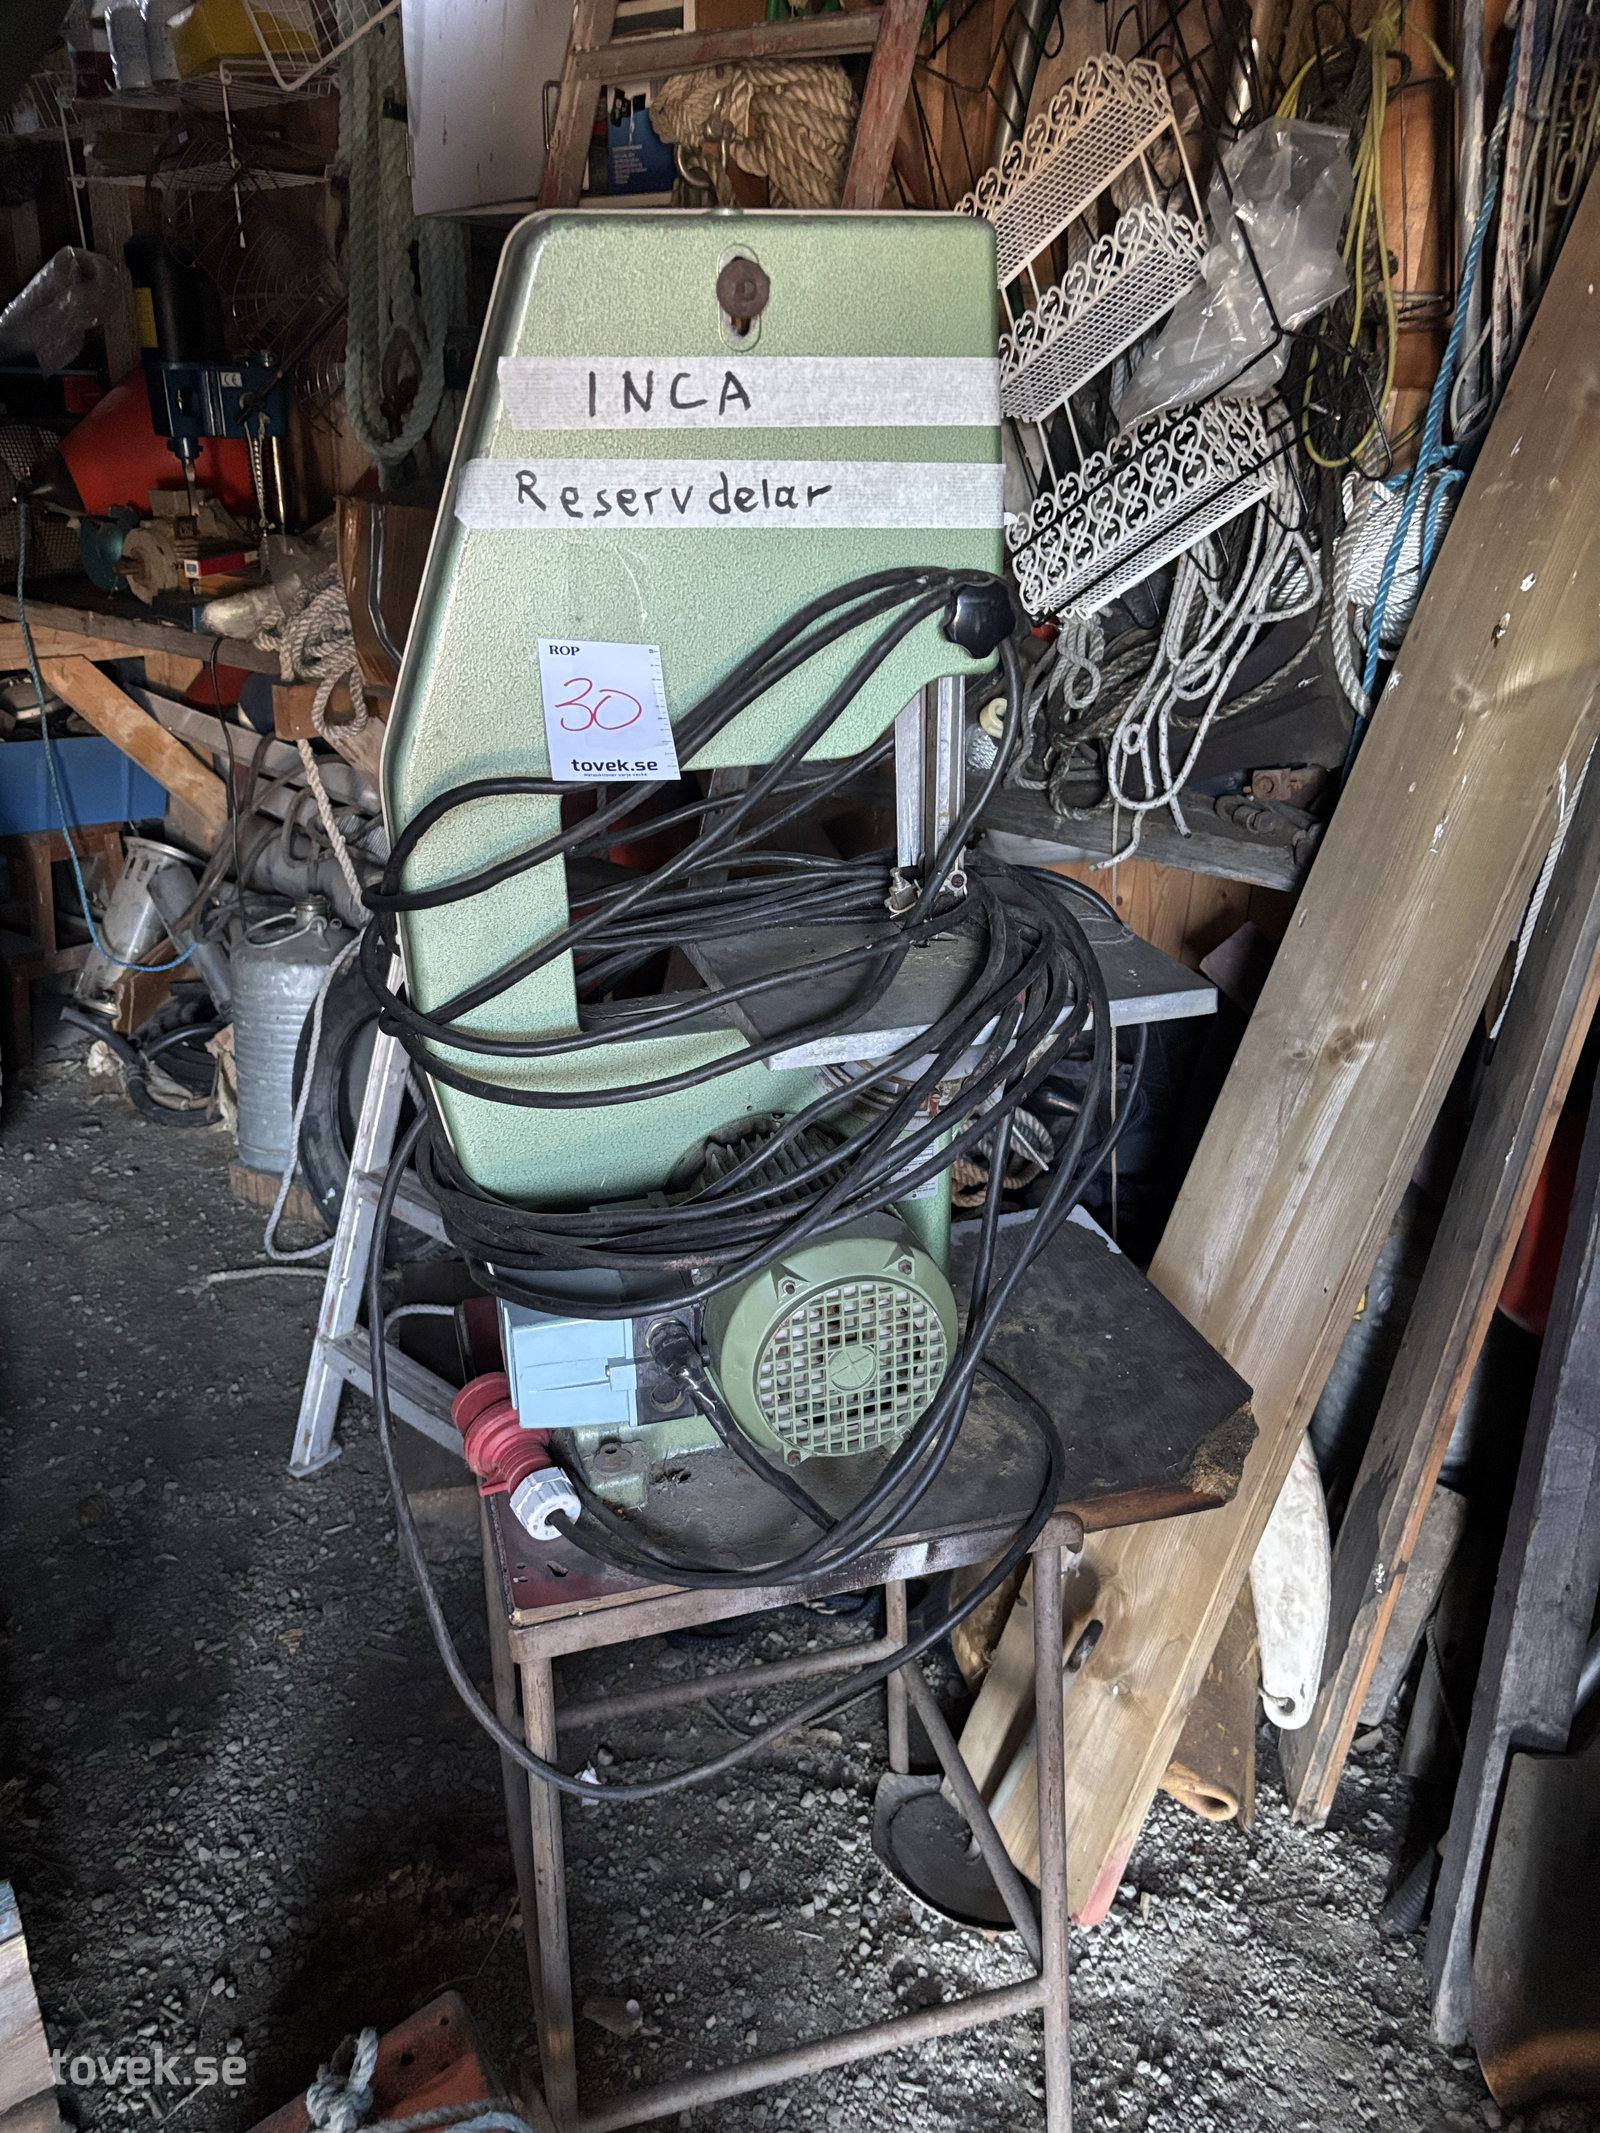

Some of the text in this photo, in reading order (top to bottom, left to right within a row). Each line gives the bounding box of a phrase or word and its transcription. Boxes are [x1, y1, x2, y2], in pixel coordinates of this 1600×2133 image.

[588, 370, 752, 418] INCA
[549, 645, 580, 656] ROP
[555, 677, 642, 732] 30
[571, 759, 658, 772] tovek.se
